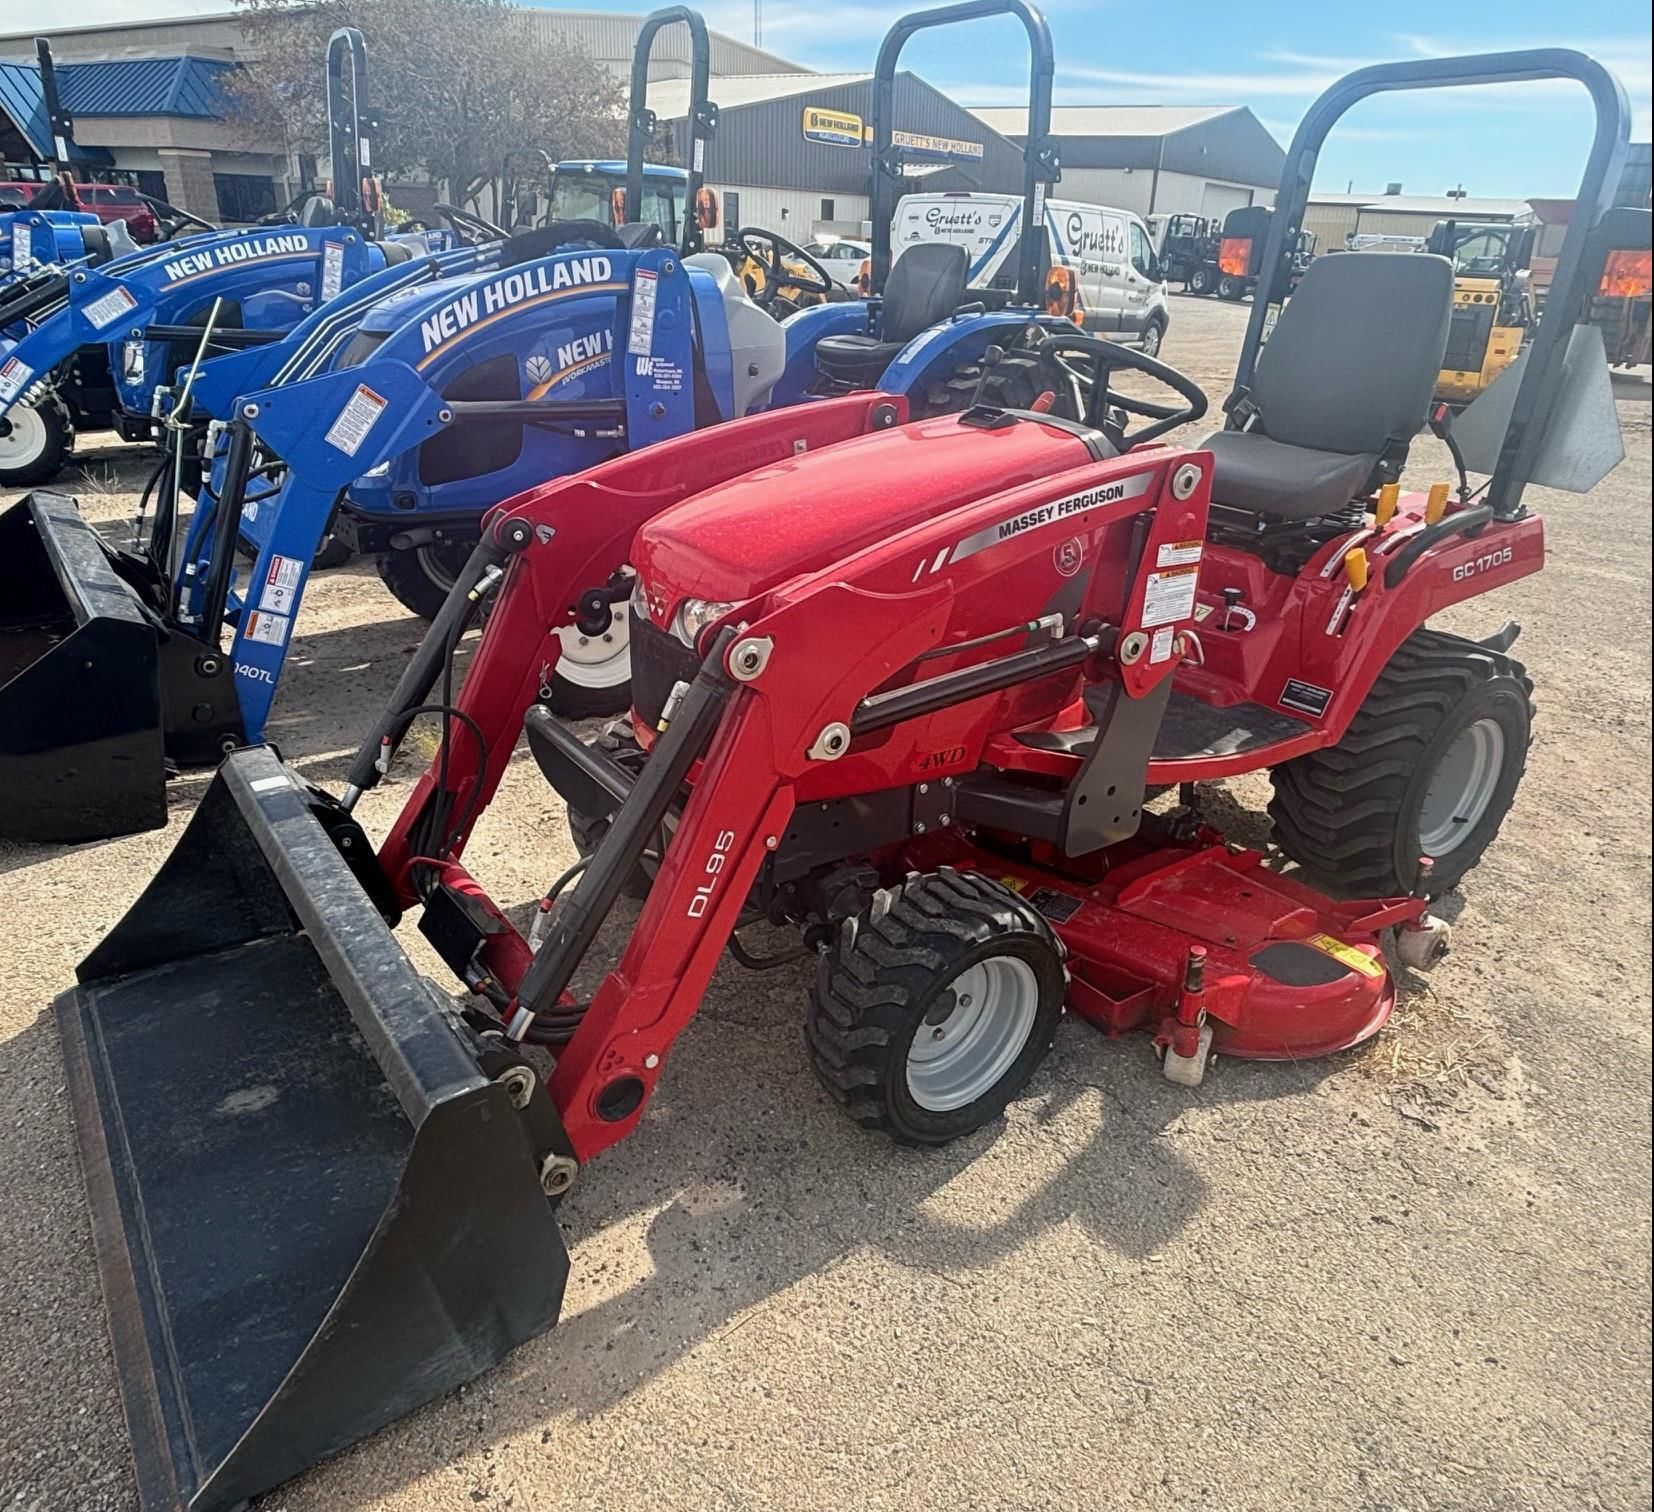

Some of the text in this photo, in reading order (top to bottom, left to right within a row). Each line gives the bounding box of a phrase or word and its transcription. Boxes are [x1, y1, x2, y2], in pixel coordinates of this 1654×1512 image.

[818, 117, 859, 132] NEW HOLLAND
[894, 132, 983, 156] GRUETT'S NEW HOLLAND
[925, 207, 982, 228] Gruett's
[1066, 212, 1124, 257] Gruett's
[164, 234, 308, 281] NEW HOLLAND
[420, 256, 612, 352] NEW HOLLAND
[557, 332, 601, 370] NEW
[999, 485, 1124, 539] MASSEY FERGUSON
[918, 746, 966, 769] 4WD
[687, 829, 735, 918] DL95
